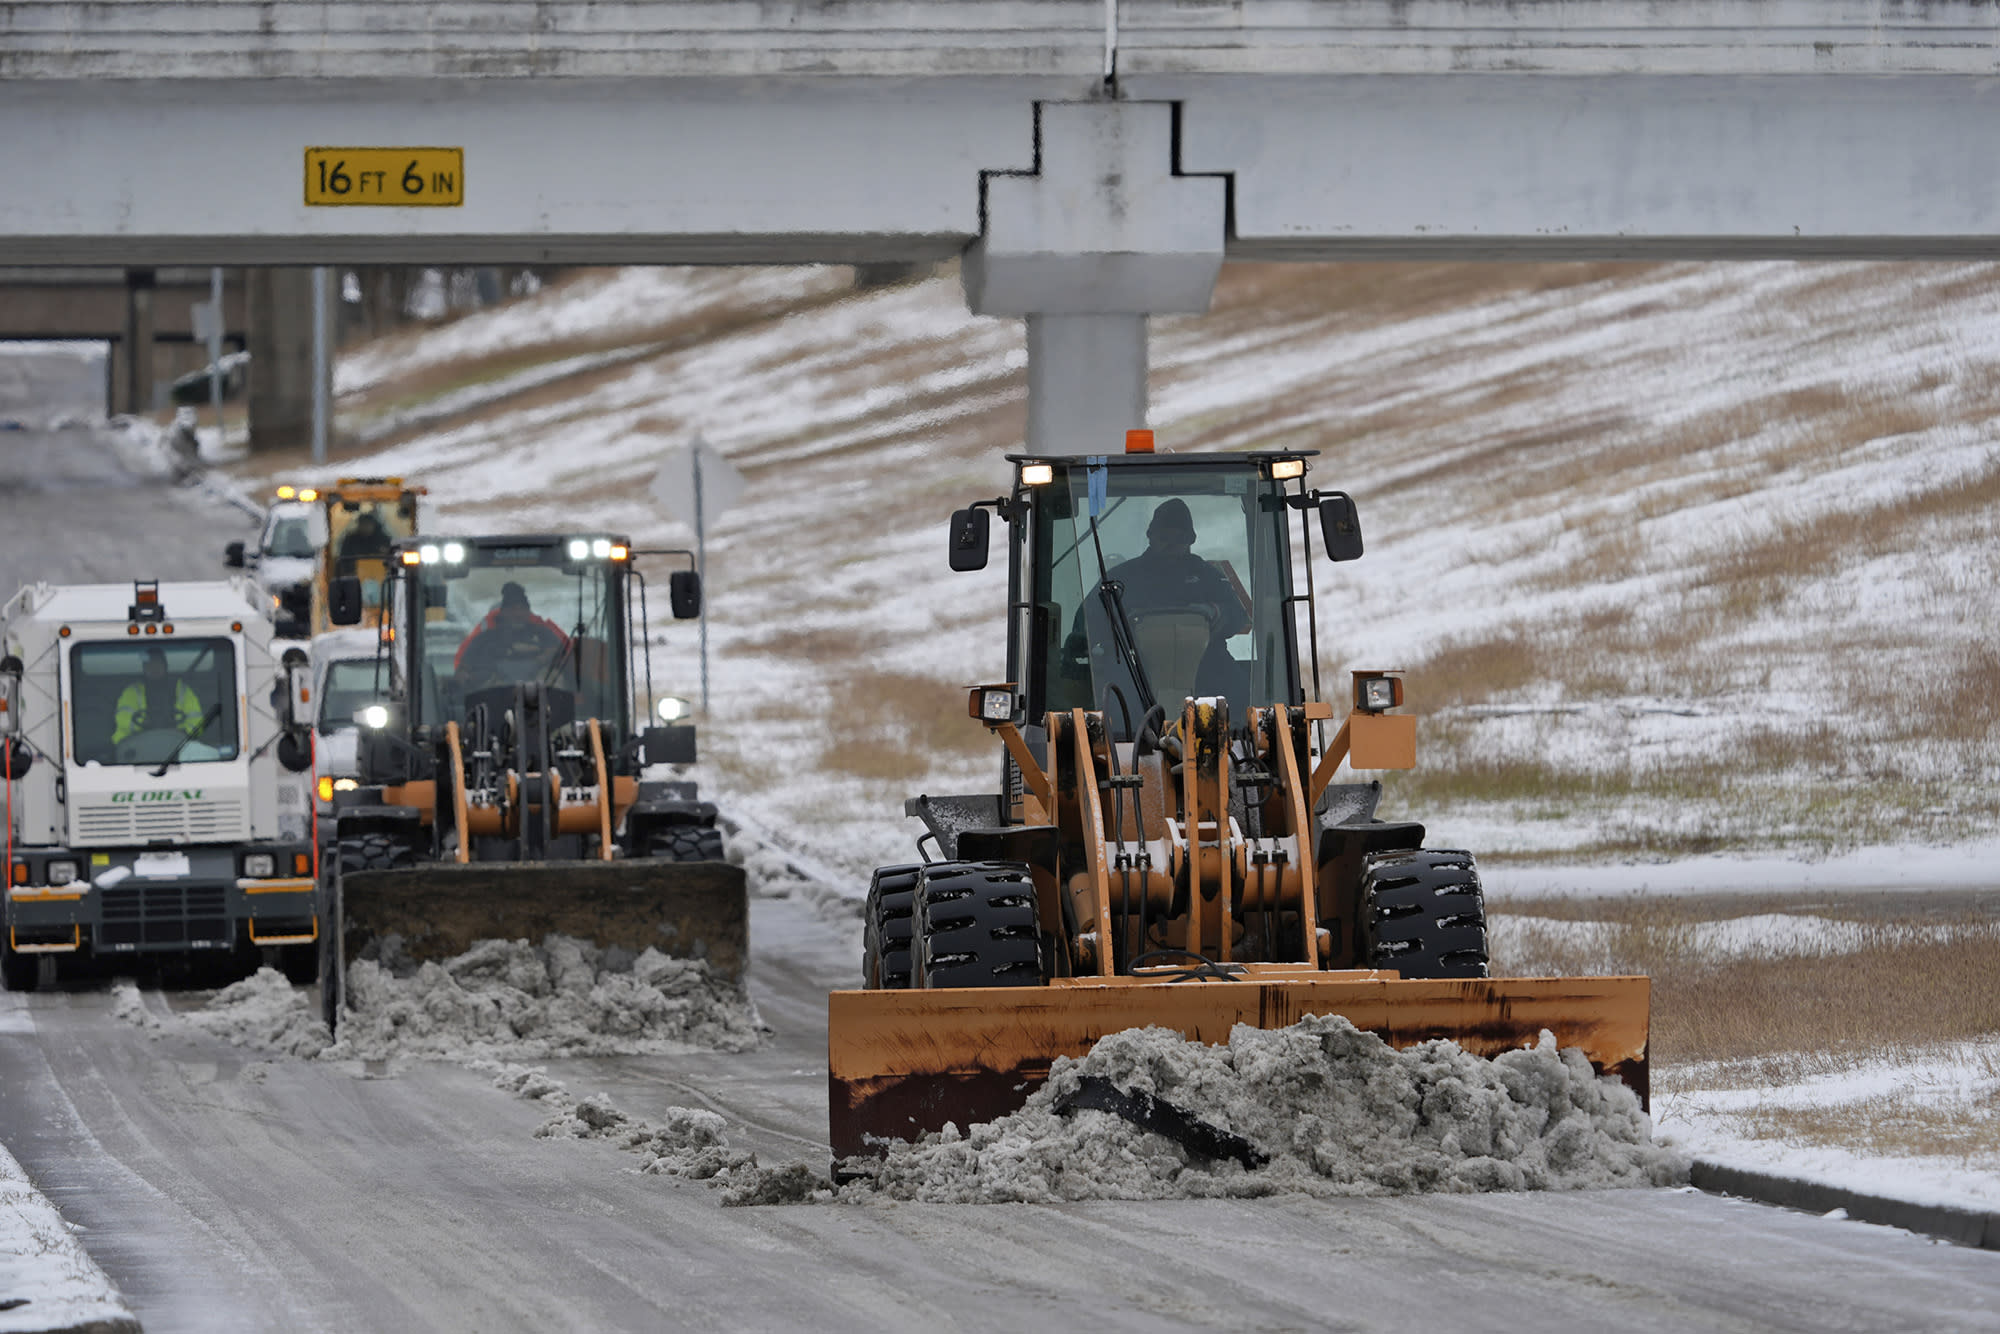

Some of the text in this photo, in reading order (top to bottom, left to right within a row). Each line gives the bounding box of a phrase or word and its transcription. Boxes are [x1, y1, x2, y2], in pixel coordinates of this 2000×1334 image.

[318, 160, 454, 194] 16 FT 6 IN
[112, 789, 205, 803] GLOBAL
